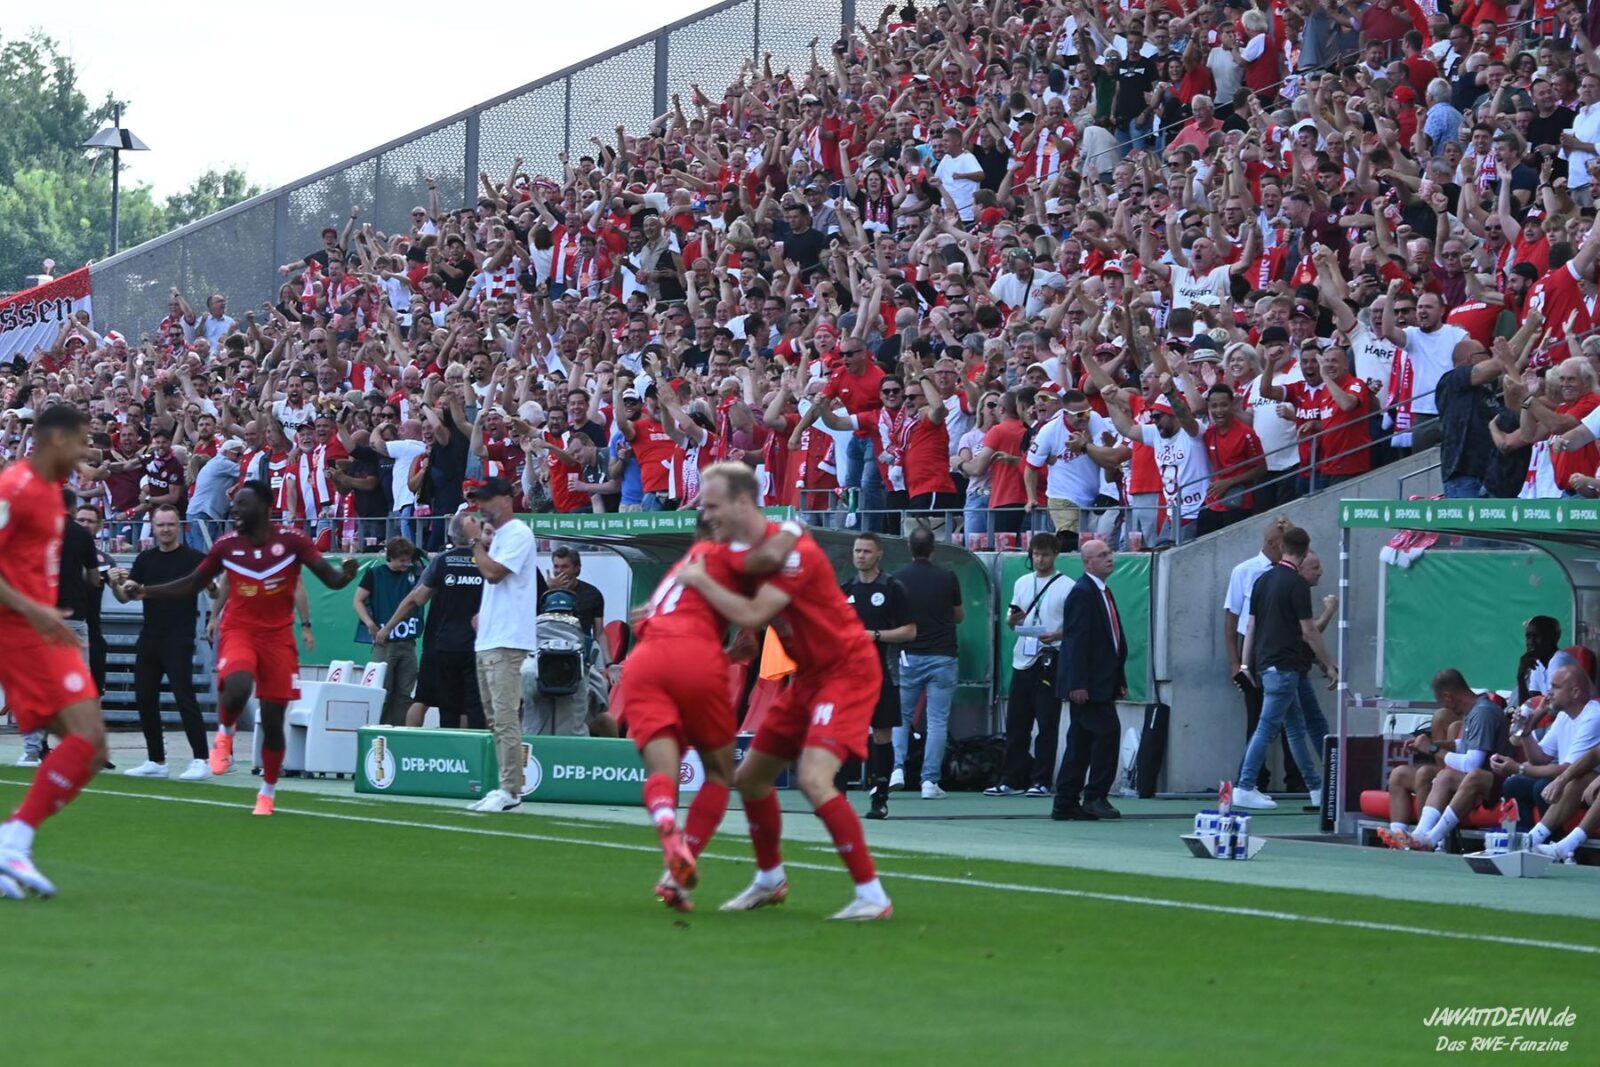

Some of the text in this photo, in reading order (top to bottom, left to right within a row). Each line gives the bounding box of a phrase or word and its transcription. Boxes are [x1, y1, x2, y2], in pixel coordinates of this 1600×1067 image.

[456, 575, 483, 586] JAKO
[401, 757, 469, 774] DFB-POKAL
[552, 764, 648, 783] DFB-POKAL
